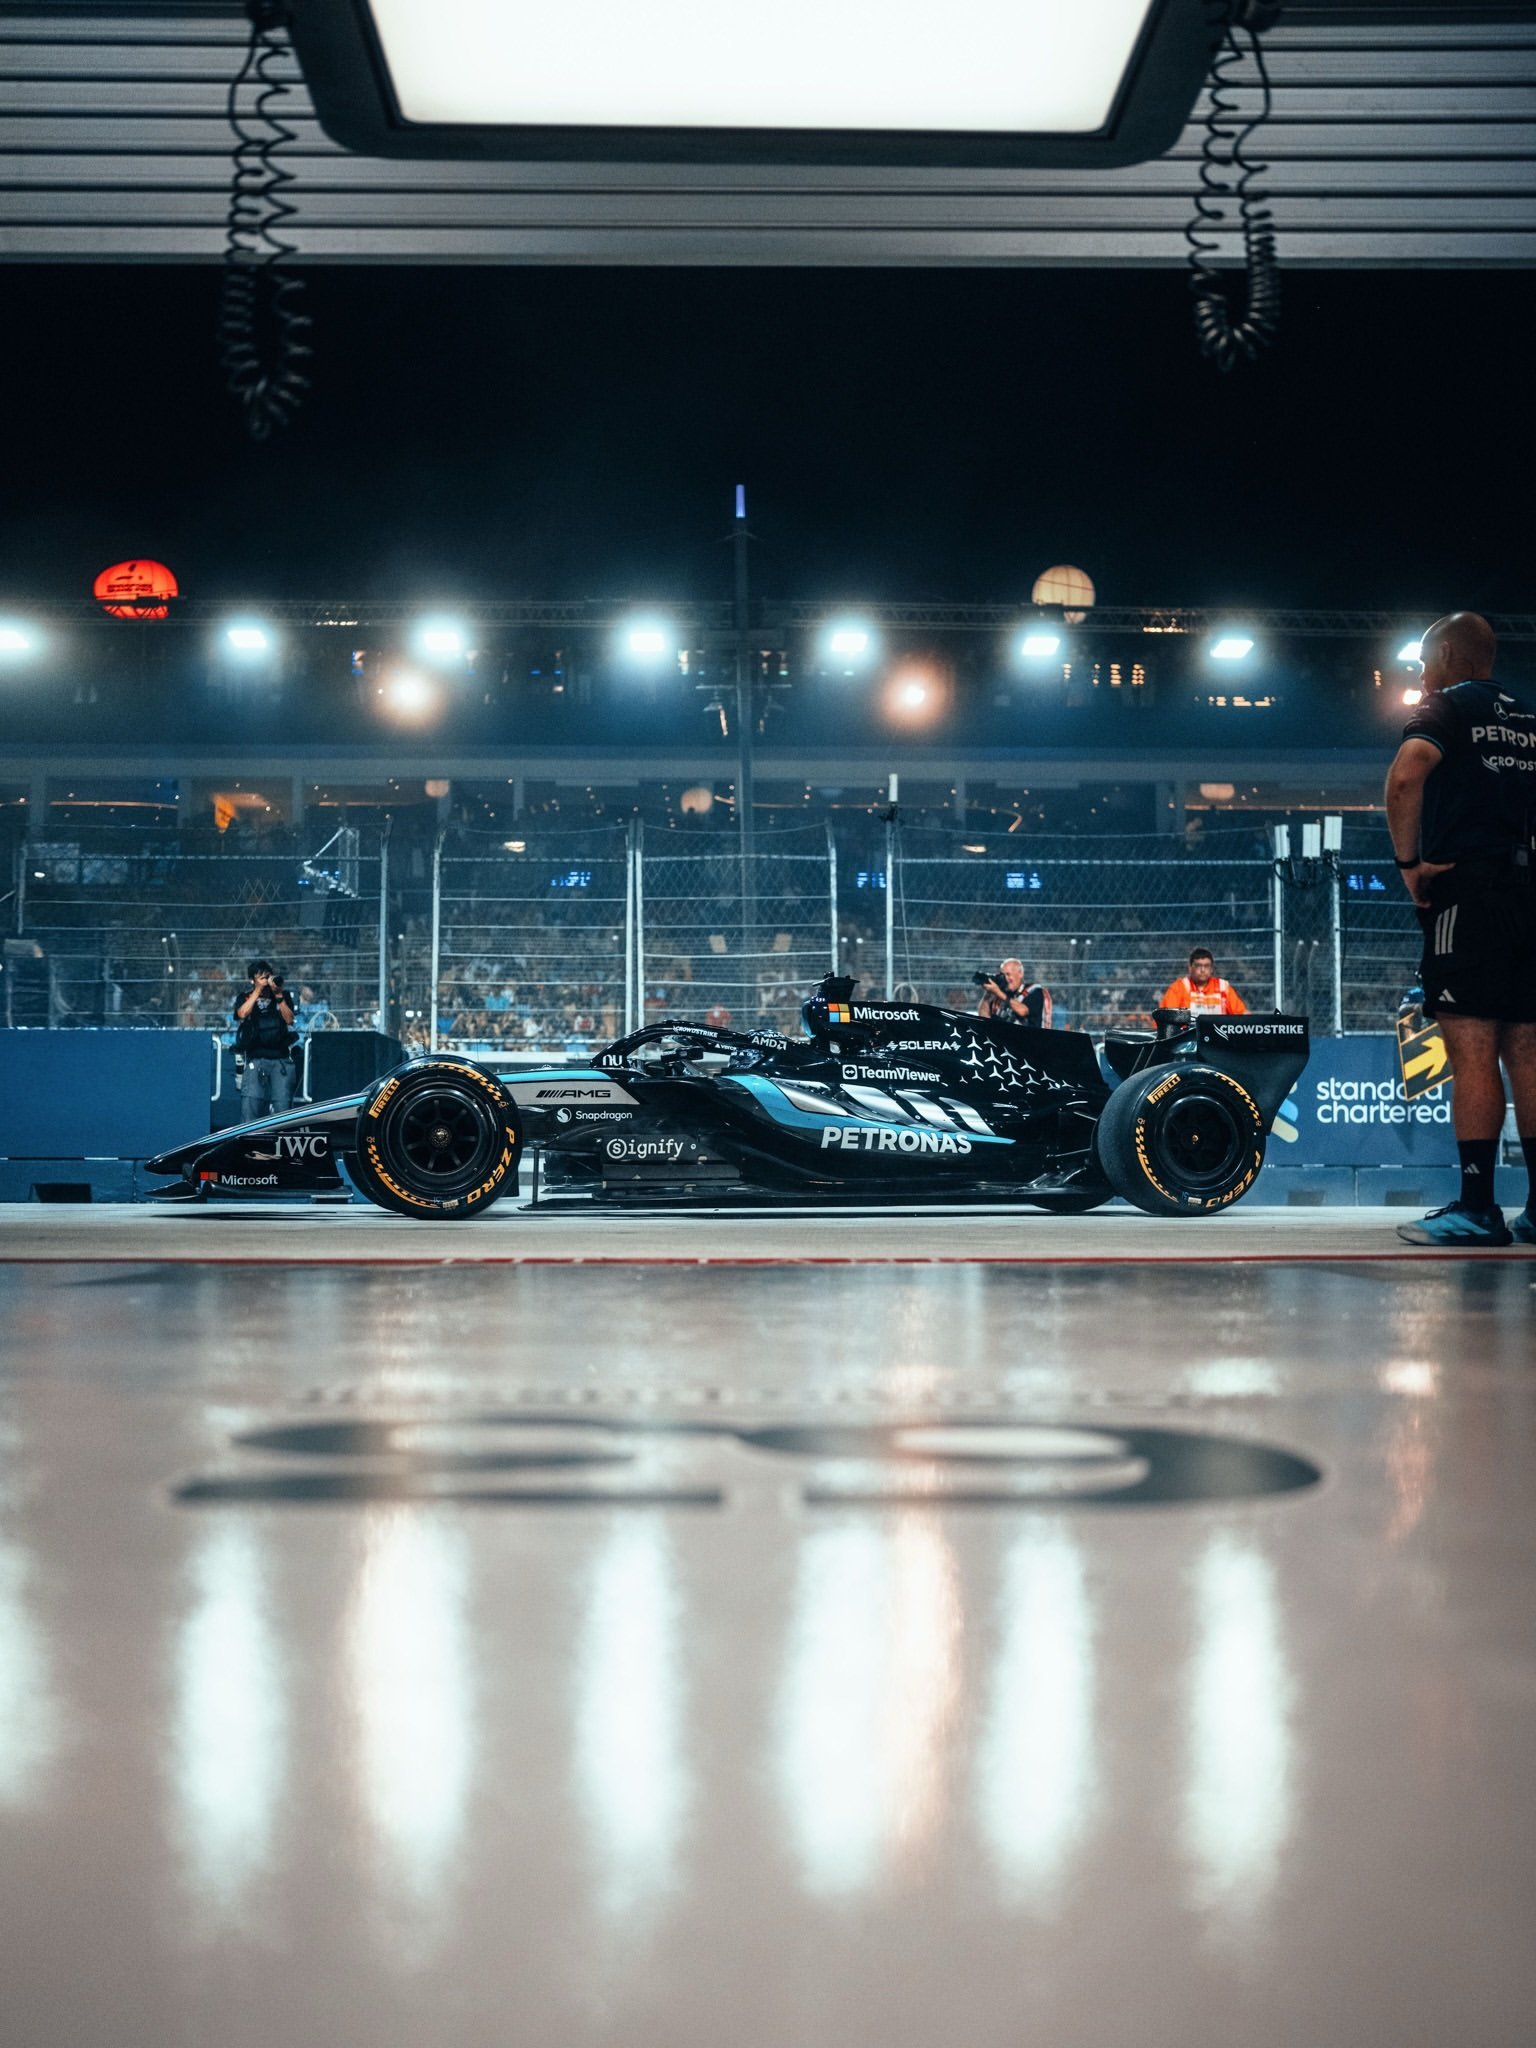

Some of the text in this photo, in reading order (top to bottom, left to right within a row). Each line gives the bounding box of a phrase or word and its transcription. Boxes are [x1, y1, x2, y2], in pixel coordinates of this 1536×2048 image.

[853, 1006, 921, 1021] Microsoft
[674, 1025, 719, 1039] CROWDSTRIKE
[1219, 1024, 1304, 1035] CROWDSTRIKE
[751, 1036, 778, 1048] AMD
[898, 1040, 952, 1051] SOLERA
[858, 1065, 941, 1083] TeamViewer
[560, 1089, 611, 1098] AMG
[1147, 1073, 1181, 1105] PIRELLI
[1316, 1077, 1443, 1101] standad
[368, 1077, 401, 1119] PIRELLI
[575, 1111, 633, 1122] Snapdragon
[1316, 1101, 1451, 1124] chartered
[275, 1136, 328, 1158] IWC
[820, 1126, 972, 1154] PETRONAS
[221, 1174, 279, 1186] Microsoft
[467, 1147, 513, 1204] ZERO
